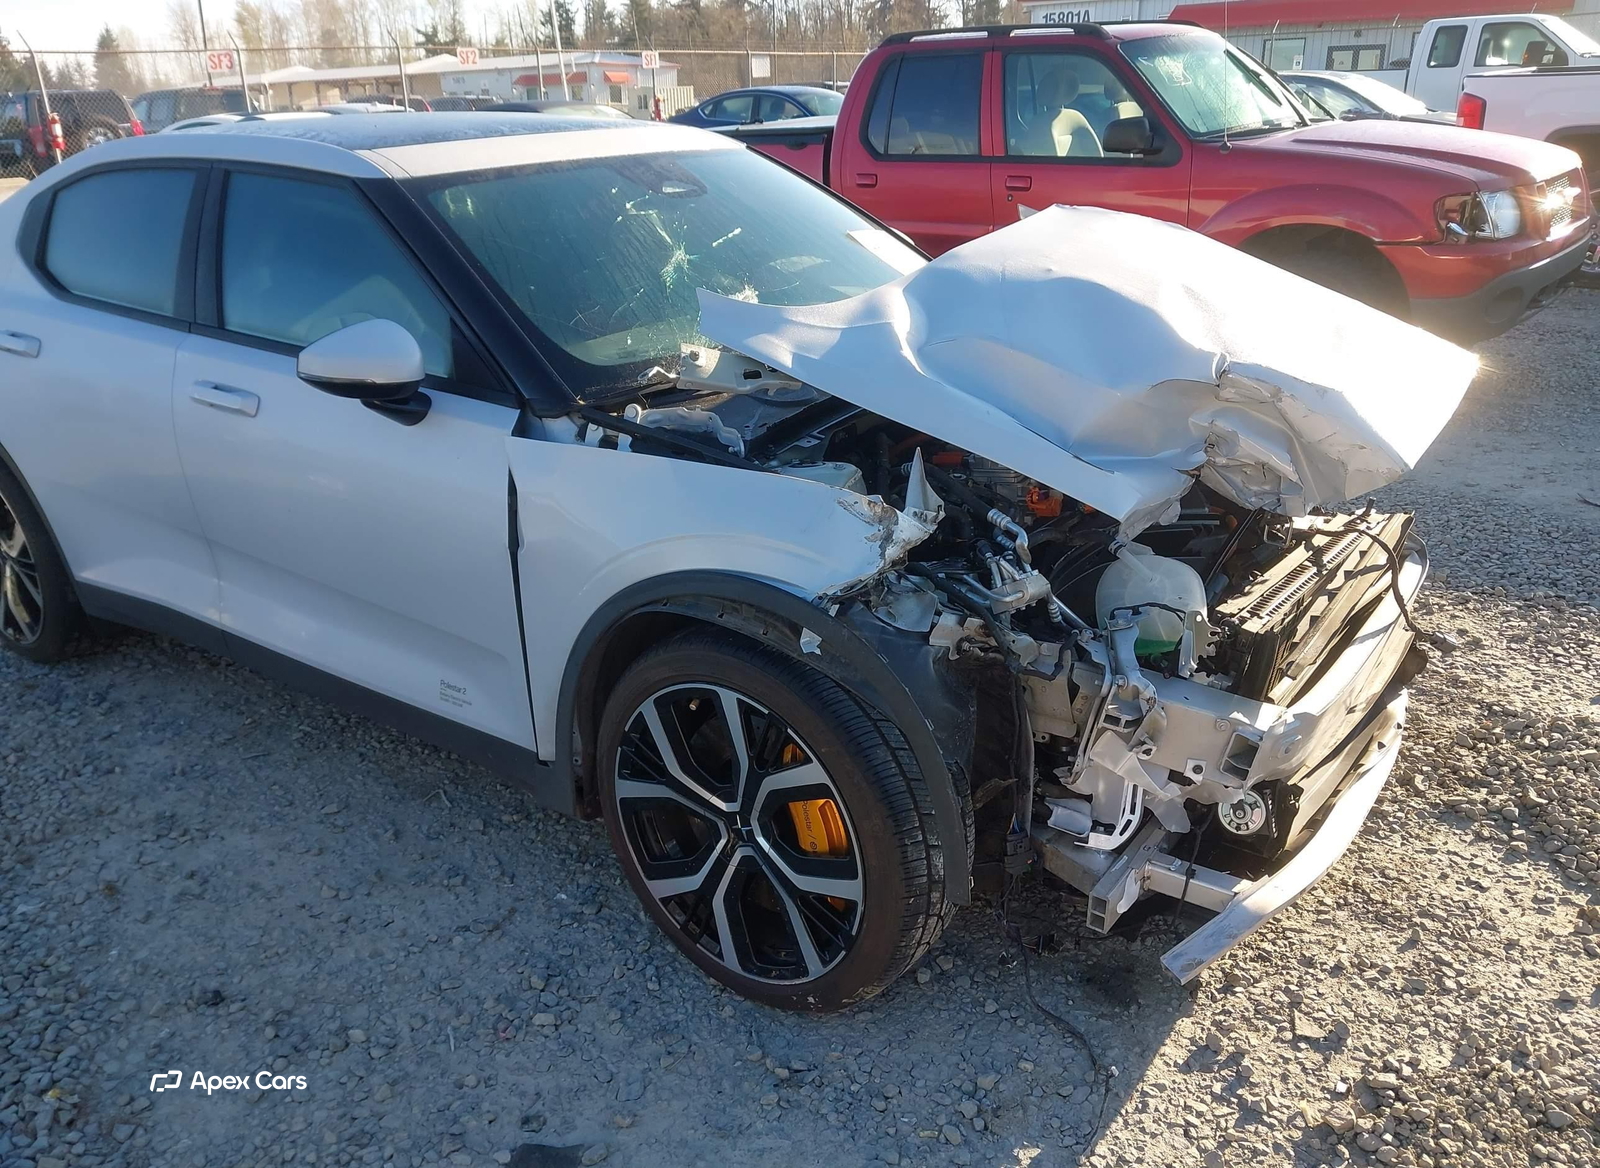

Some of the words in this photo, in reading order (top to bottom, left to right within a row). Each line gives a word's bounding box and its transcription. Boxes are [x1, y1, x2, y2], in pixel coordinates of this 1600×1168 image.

[1042, 9, 1091, 23] 15801A
[208, 52, 233, 70] SF3
[459, 49, 477, 65] SF2
[644, 53, 657, 66] SF1
[462, 687, 467, 695] 2
